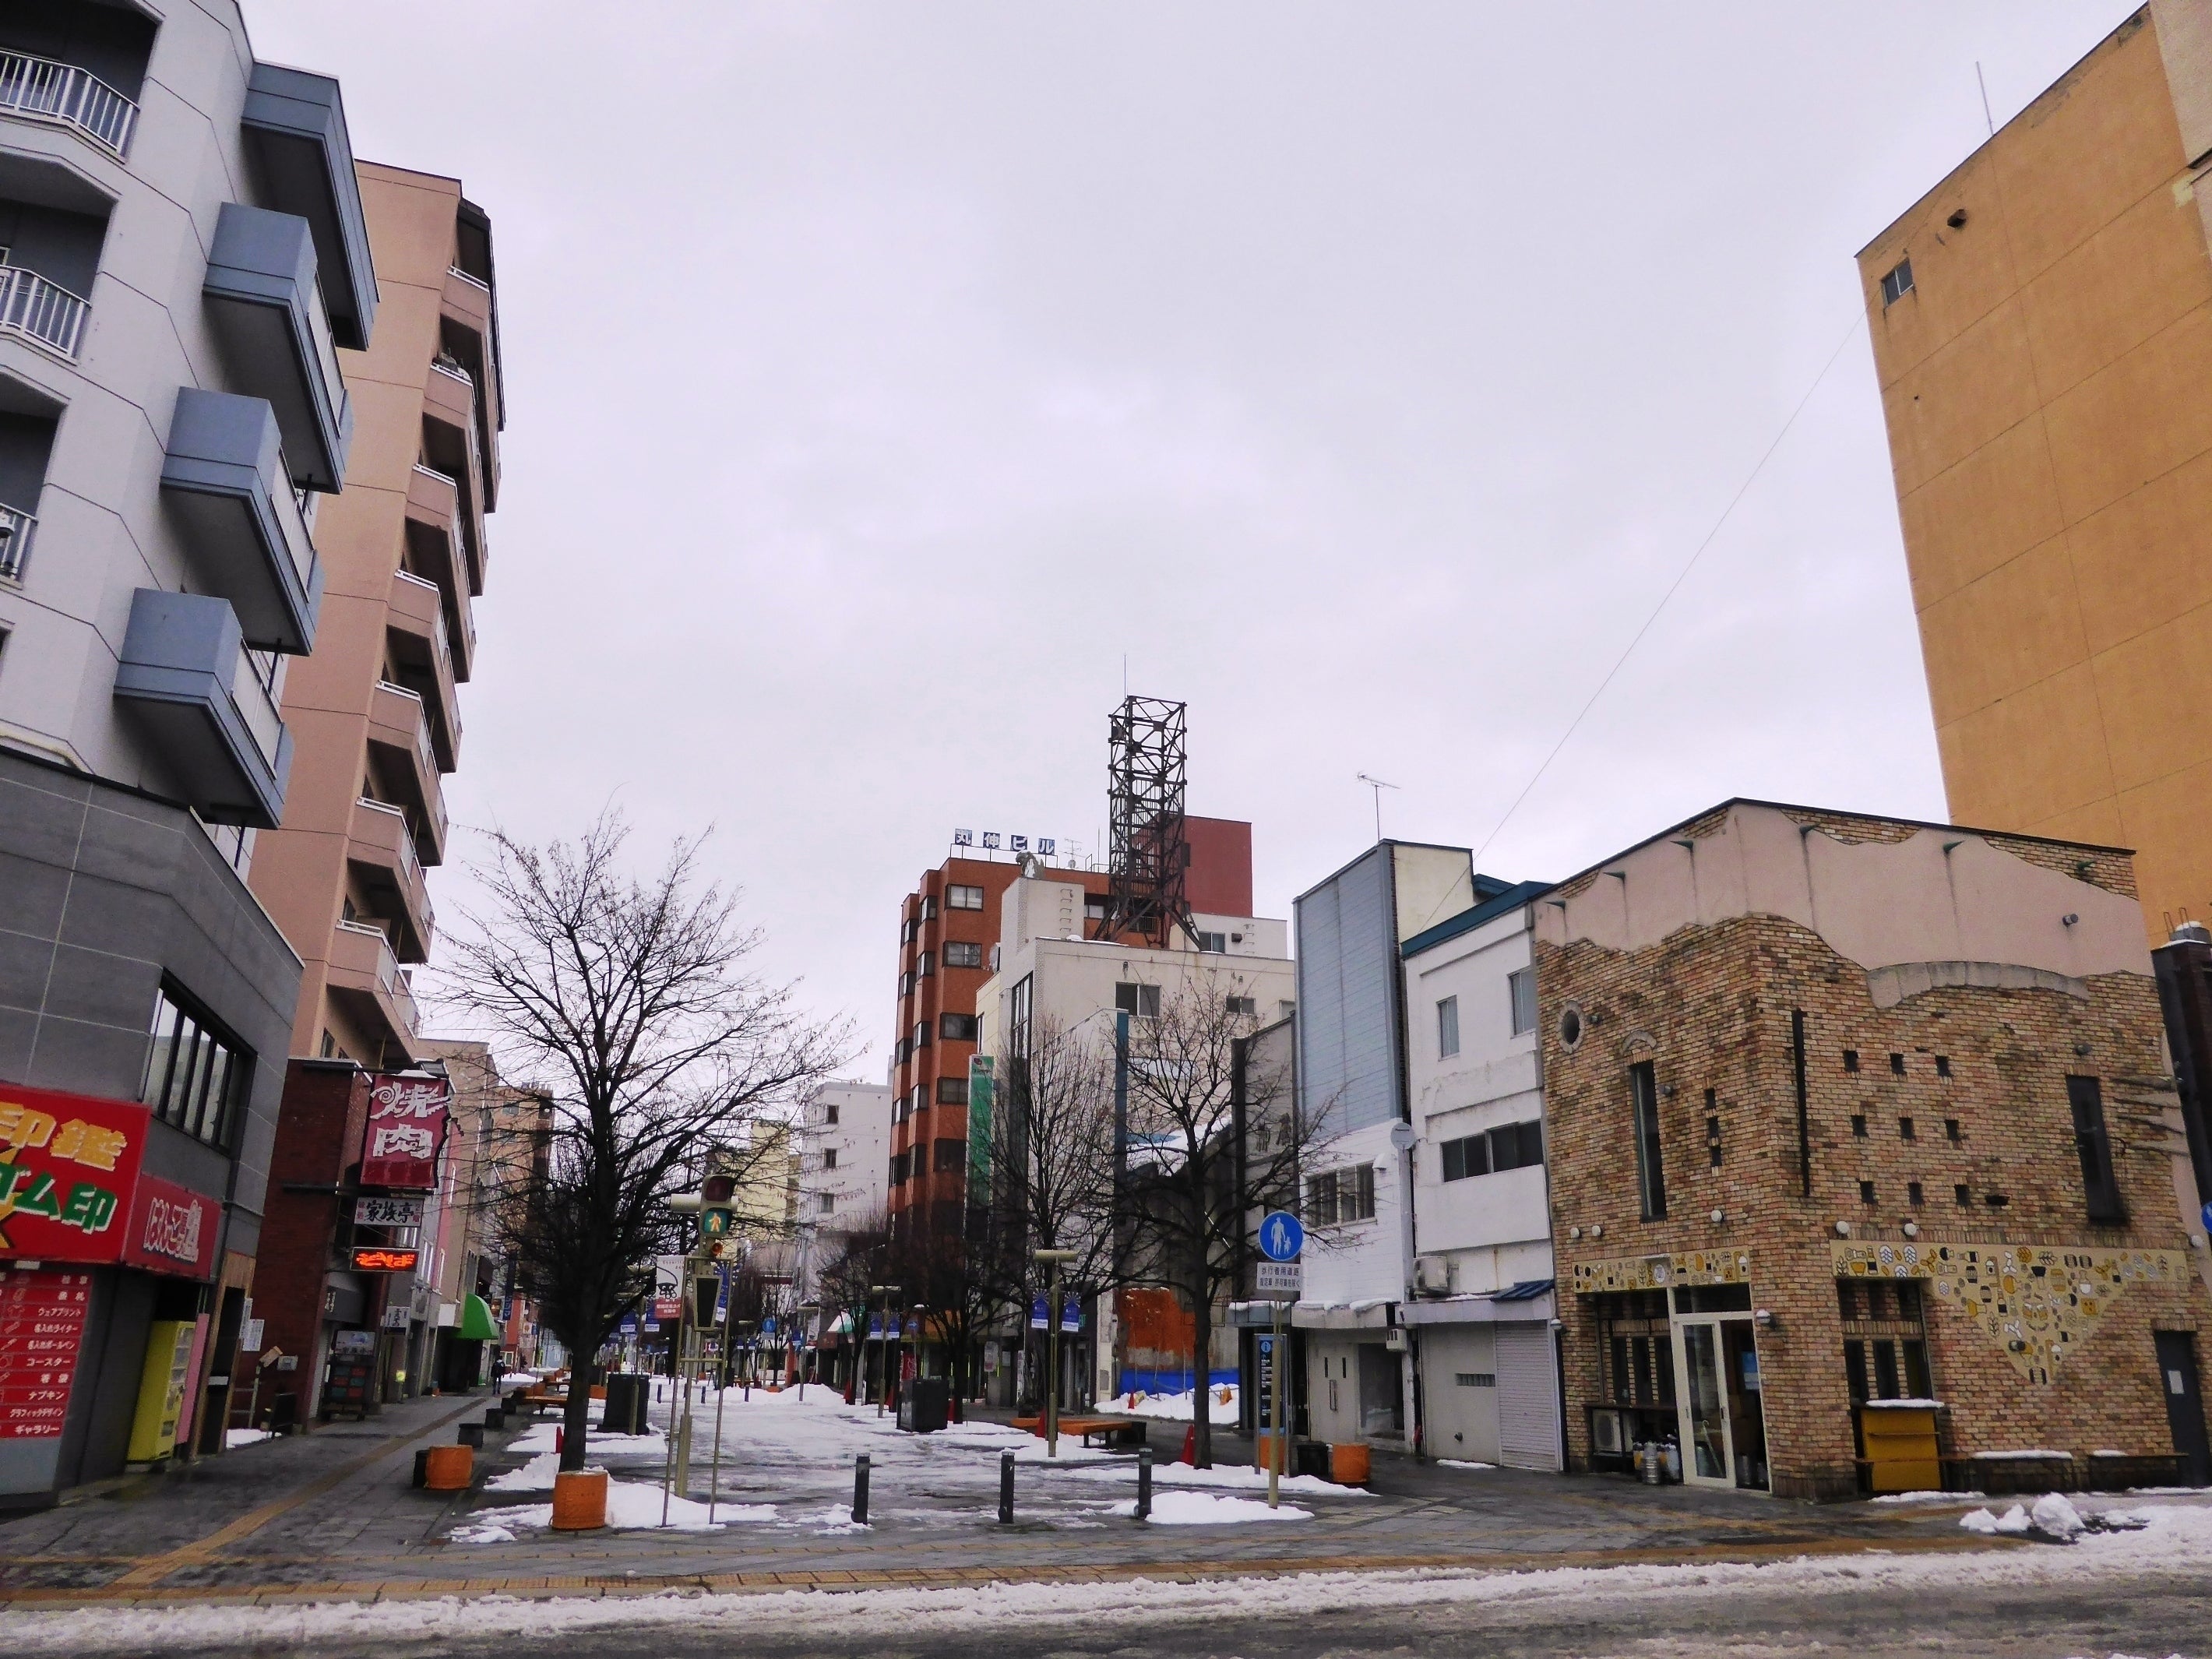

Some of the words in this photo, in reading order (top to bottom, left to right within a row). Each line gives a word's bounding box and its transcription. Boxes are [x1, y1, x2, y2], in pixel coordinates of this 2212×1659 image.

[955, 829, 1055, 855] 丸伸ビル
[369, 1081, 452, 1160] 焼肉
[364, 1199, 414, 1224] 家族亭
[26, 1357, 71, 1367] コースター
[28, 1390, 65, 1400] ナプキン
[15, 1425, 60, 1434] ギャラリー
